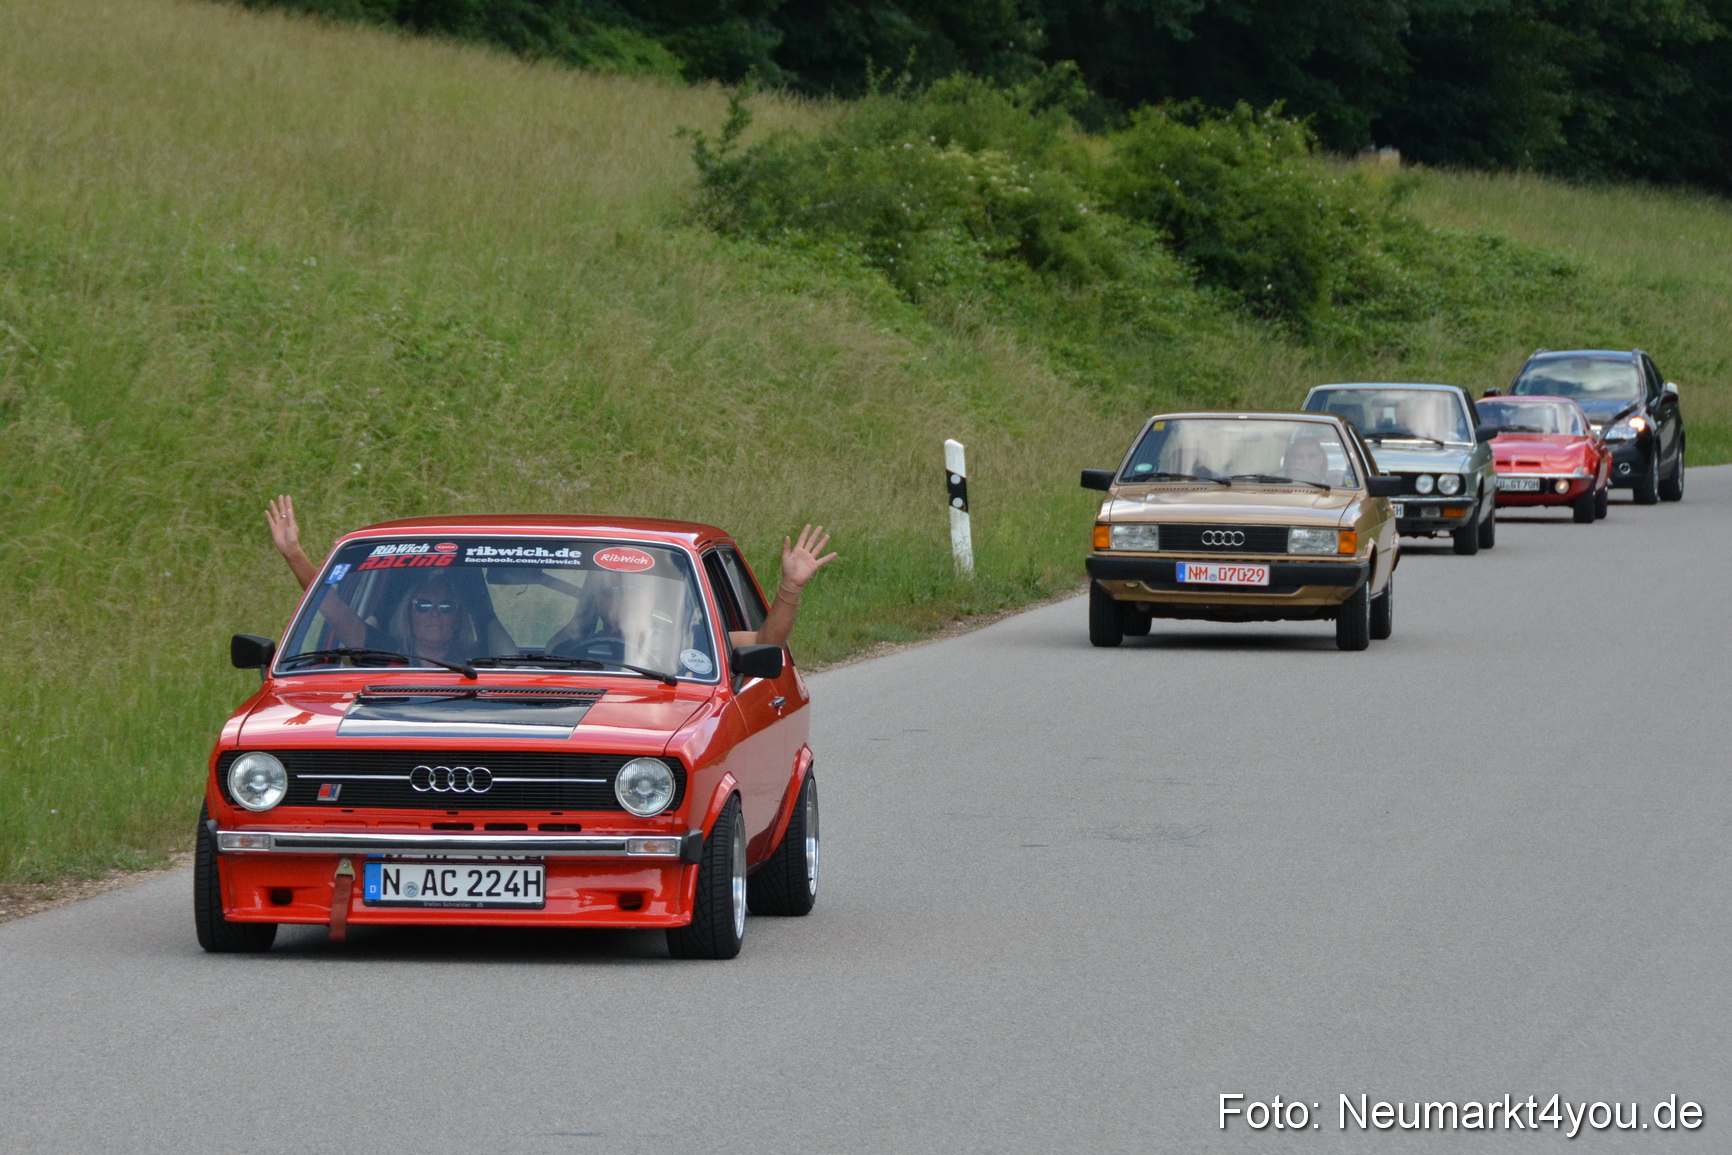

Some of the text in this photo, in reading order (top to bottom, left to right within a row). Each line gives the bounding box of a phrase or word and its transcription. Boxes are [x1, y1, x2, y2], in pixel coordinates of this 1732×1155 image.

[1510, 480, 1521, 489] GT
[1523, 480, 1539, 489] 70H
[369, 543, 430, 556] RibWich
[465, 545, 582, 559] ribwich.de
[464, 556, 581, 565] facebook.com/ribwich
[600, 553, 649, 565] RibWich
[1188, 566, 1265, 583] NM 07029
[382, 868, 541, 897] N AC 224H
[369, 885, 377, 893] D
